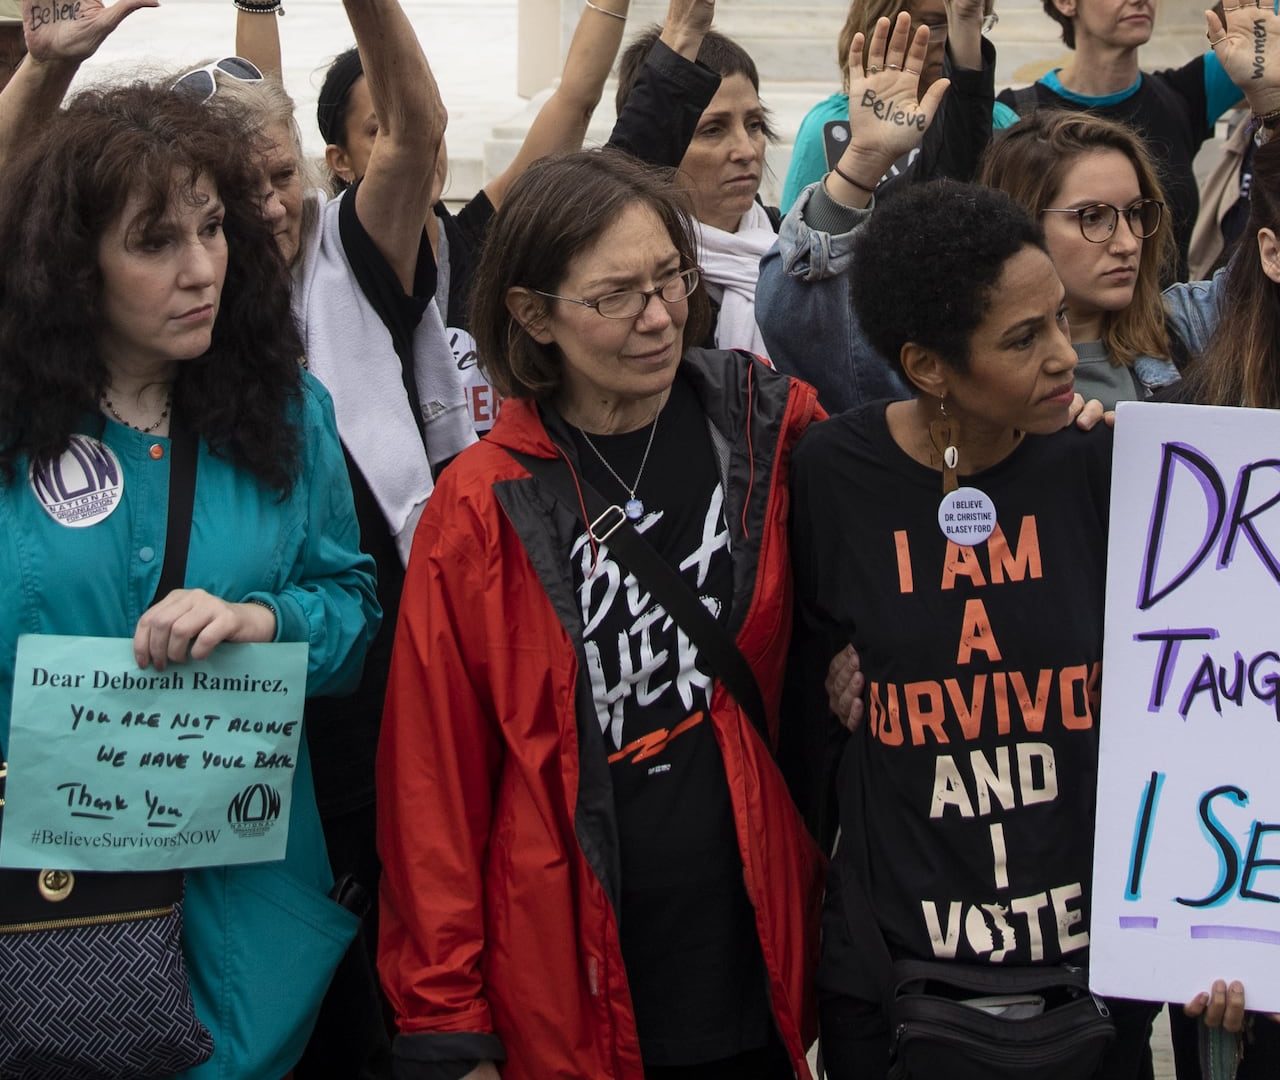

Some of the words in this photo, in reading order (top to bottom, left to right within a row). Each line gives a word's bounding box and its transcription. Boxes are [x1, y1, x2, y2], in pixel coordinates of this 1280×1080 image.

[49, 490, 117, 512] NATIONAL
[952, 501, 955, 509] I
[956, 500, 983, 509] BELIEVE
[946, 525, 973, 534] BLASEY
[973, 524, 992, 533] FORD
[957, 512, 992, 522] CHRISTINE
[893, 529, 914, 594] I
[940, 514, 1044, 591] AM
[956, 597, 1003, 665] A
[31, 667, 86, 688] Dear
[92, 669, 185, 690] Deborah
[192, 672, 289, 694] Ramirez,
[869, 660, 1101, 747] URVIVO
[120, 711, 161, 728] ARE
[227, 717, 299, 737] ALONE
[96, 745, 128, 767] WE
[139, 752, 190, 770] HAVE
[928, 742, 1059, 820] AND
[56, 782, 129, 811] Thank
[227, 783, 281, 824] NOW
[31, 828, 221, 850] #BelieveSurvivorsNOW
[1122, 769, 1165, 902] I
[988, 822, 1010, 890] I
